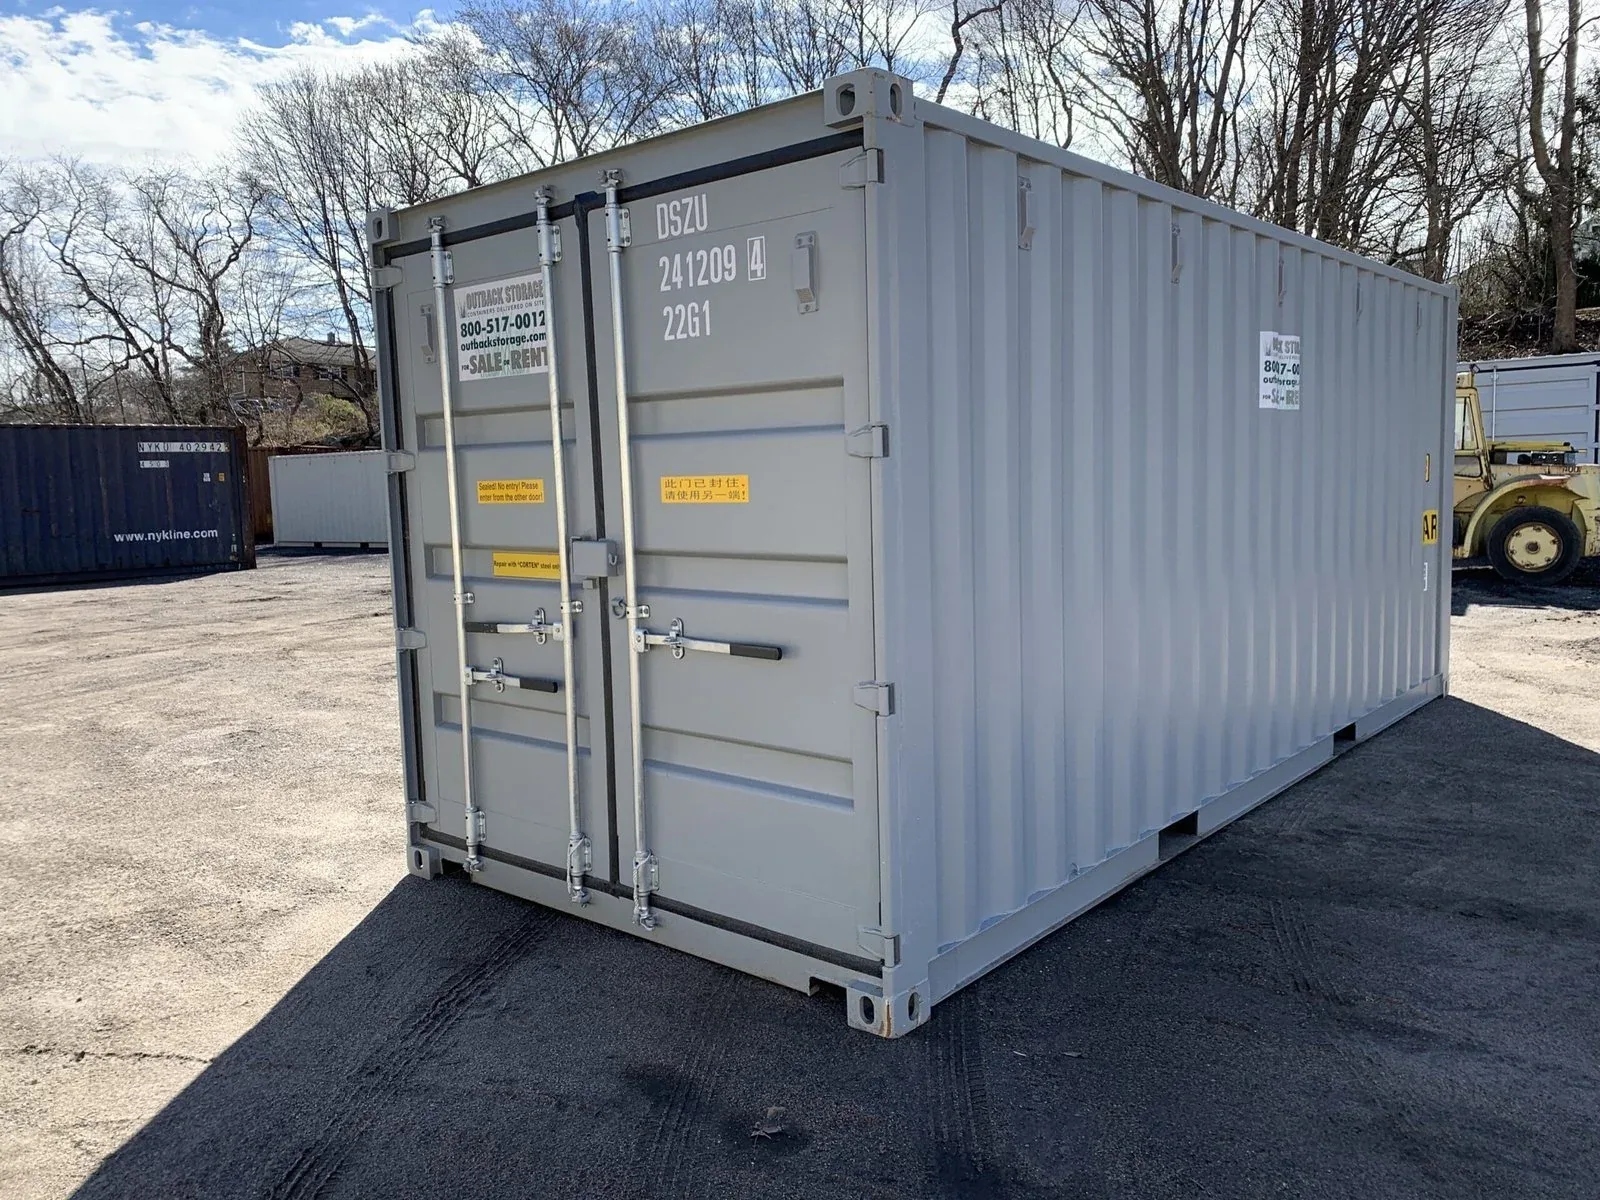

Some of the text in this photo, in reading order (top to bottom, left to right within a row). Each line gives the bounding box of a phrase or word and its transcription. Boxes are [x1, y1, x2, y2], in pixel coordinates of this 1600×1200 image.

[656, 193, 708, 240] DSZU
[659, 238, 764, 292] 241209 4
[466, 280, 544, 310] OUTBACK STORAGE
[467, 309, 495, 318] CONTAINERS
[496, 304, 523, 313] DELIVERED
[525, 301, 534, 309] ON
[460, 310, 546, 338] 800-517-0012
[663, 299, 711, 341] 22G1
[460, 332, 547, 352] outbackstorage.com
[469, 351, 503, 375] SALE
[510, 346, 549, 370] RENT
[138, 442, 169, 452] NYKU
[497, 482, 505, 490] No
[521, 481, 539, 490] Please
[492, 493, 505, 502] from
[504, 493, 514, 501] the
[513, 493, 528, 501] other
[113, 528, 219, 543] www.nykline.com
[493, 560, 508, 568] Repair
